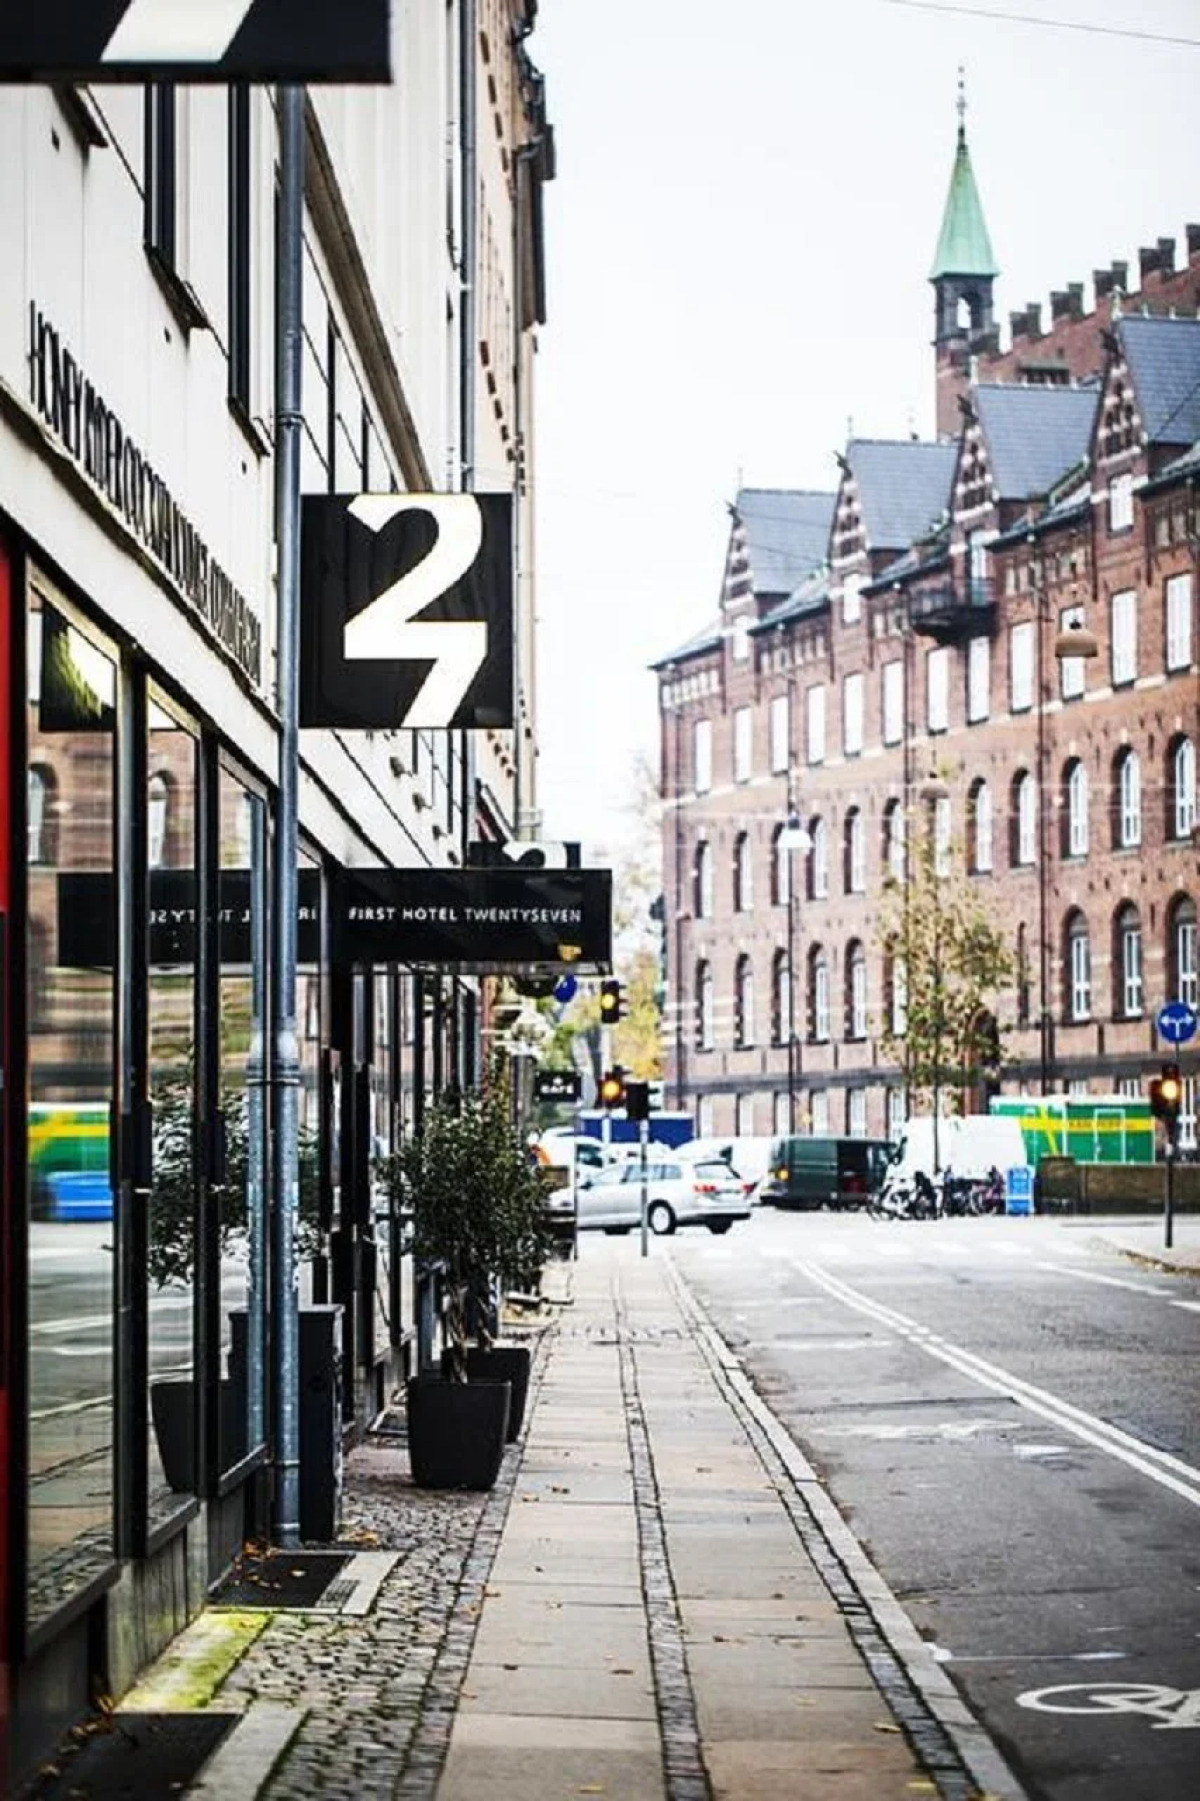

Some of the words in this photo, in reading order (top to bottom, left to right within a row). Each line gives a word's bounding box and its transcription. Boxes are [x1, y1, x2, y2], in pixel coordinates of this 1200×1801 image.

[344, 493, 488, 728] 27
[349, 907, 396, 920] FIRST
[403, 907, 458, 921] HOTEL
[464, 907, 582, 922] TWENTYSEVEN
